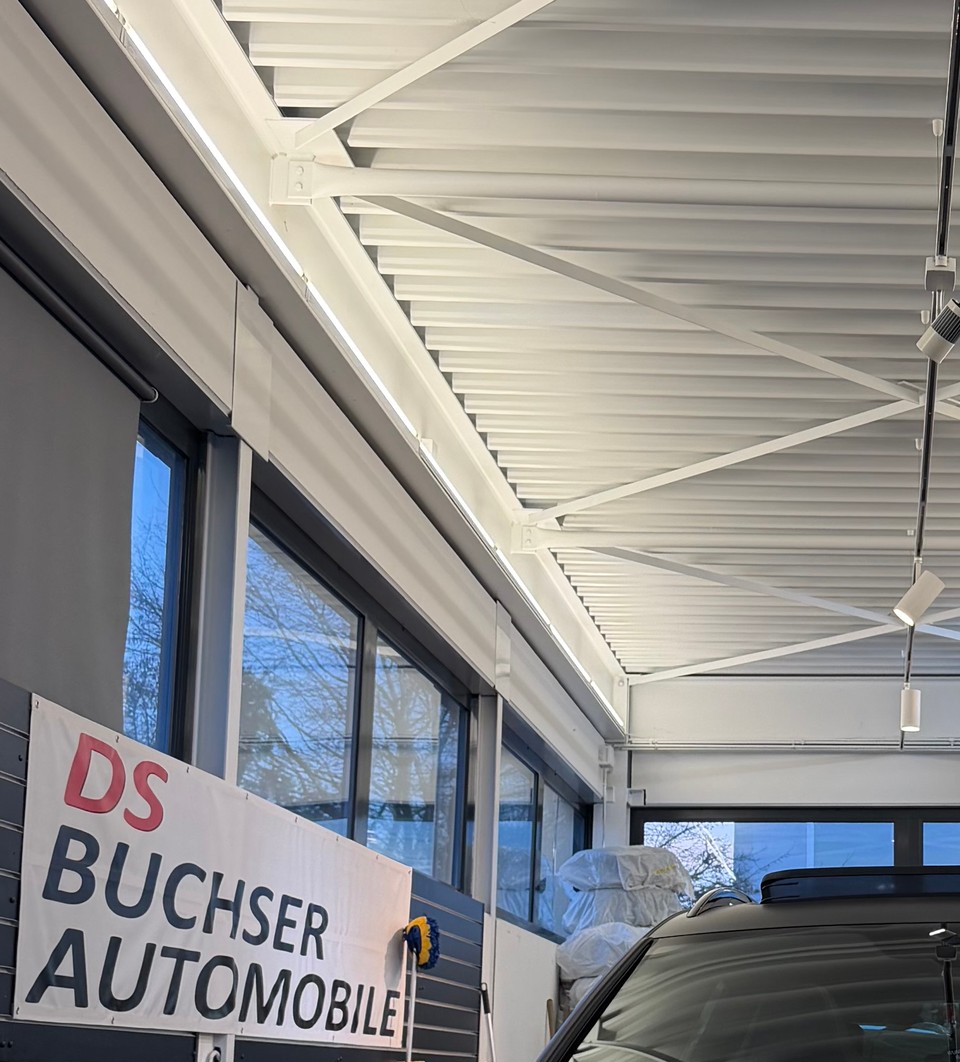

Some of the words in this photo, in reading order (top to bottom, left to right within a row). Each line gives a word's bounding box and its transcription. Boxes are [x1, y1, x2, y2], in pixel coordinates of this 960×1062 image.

[64, 732, 168, 832] DS
[42, 825, 328, 959] BUCHSER
[25, 928, 400, 1037] AUTOMOBILE
